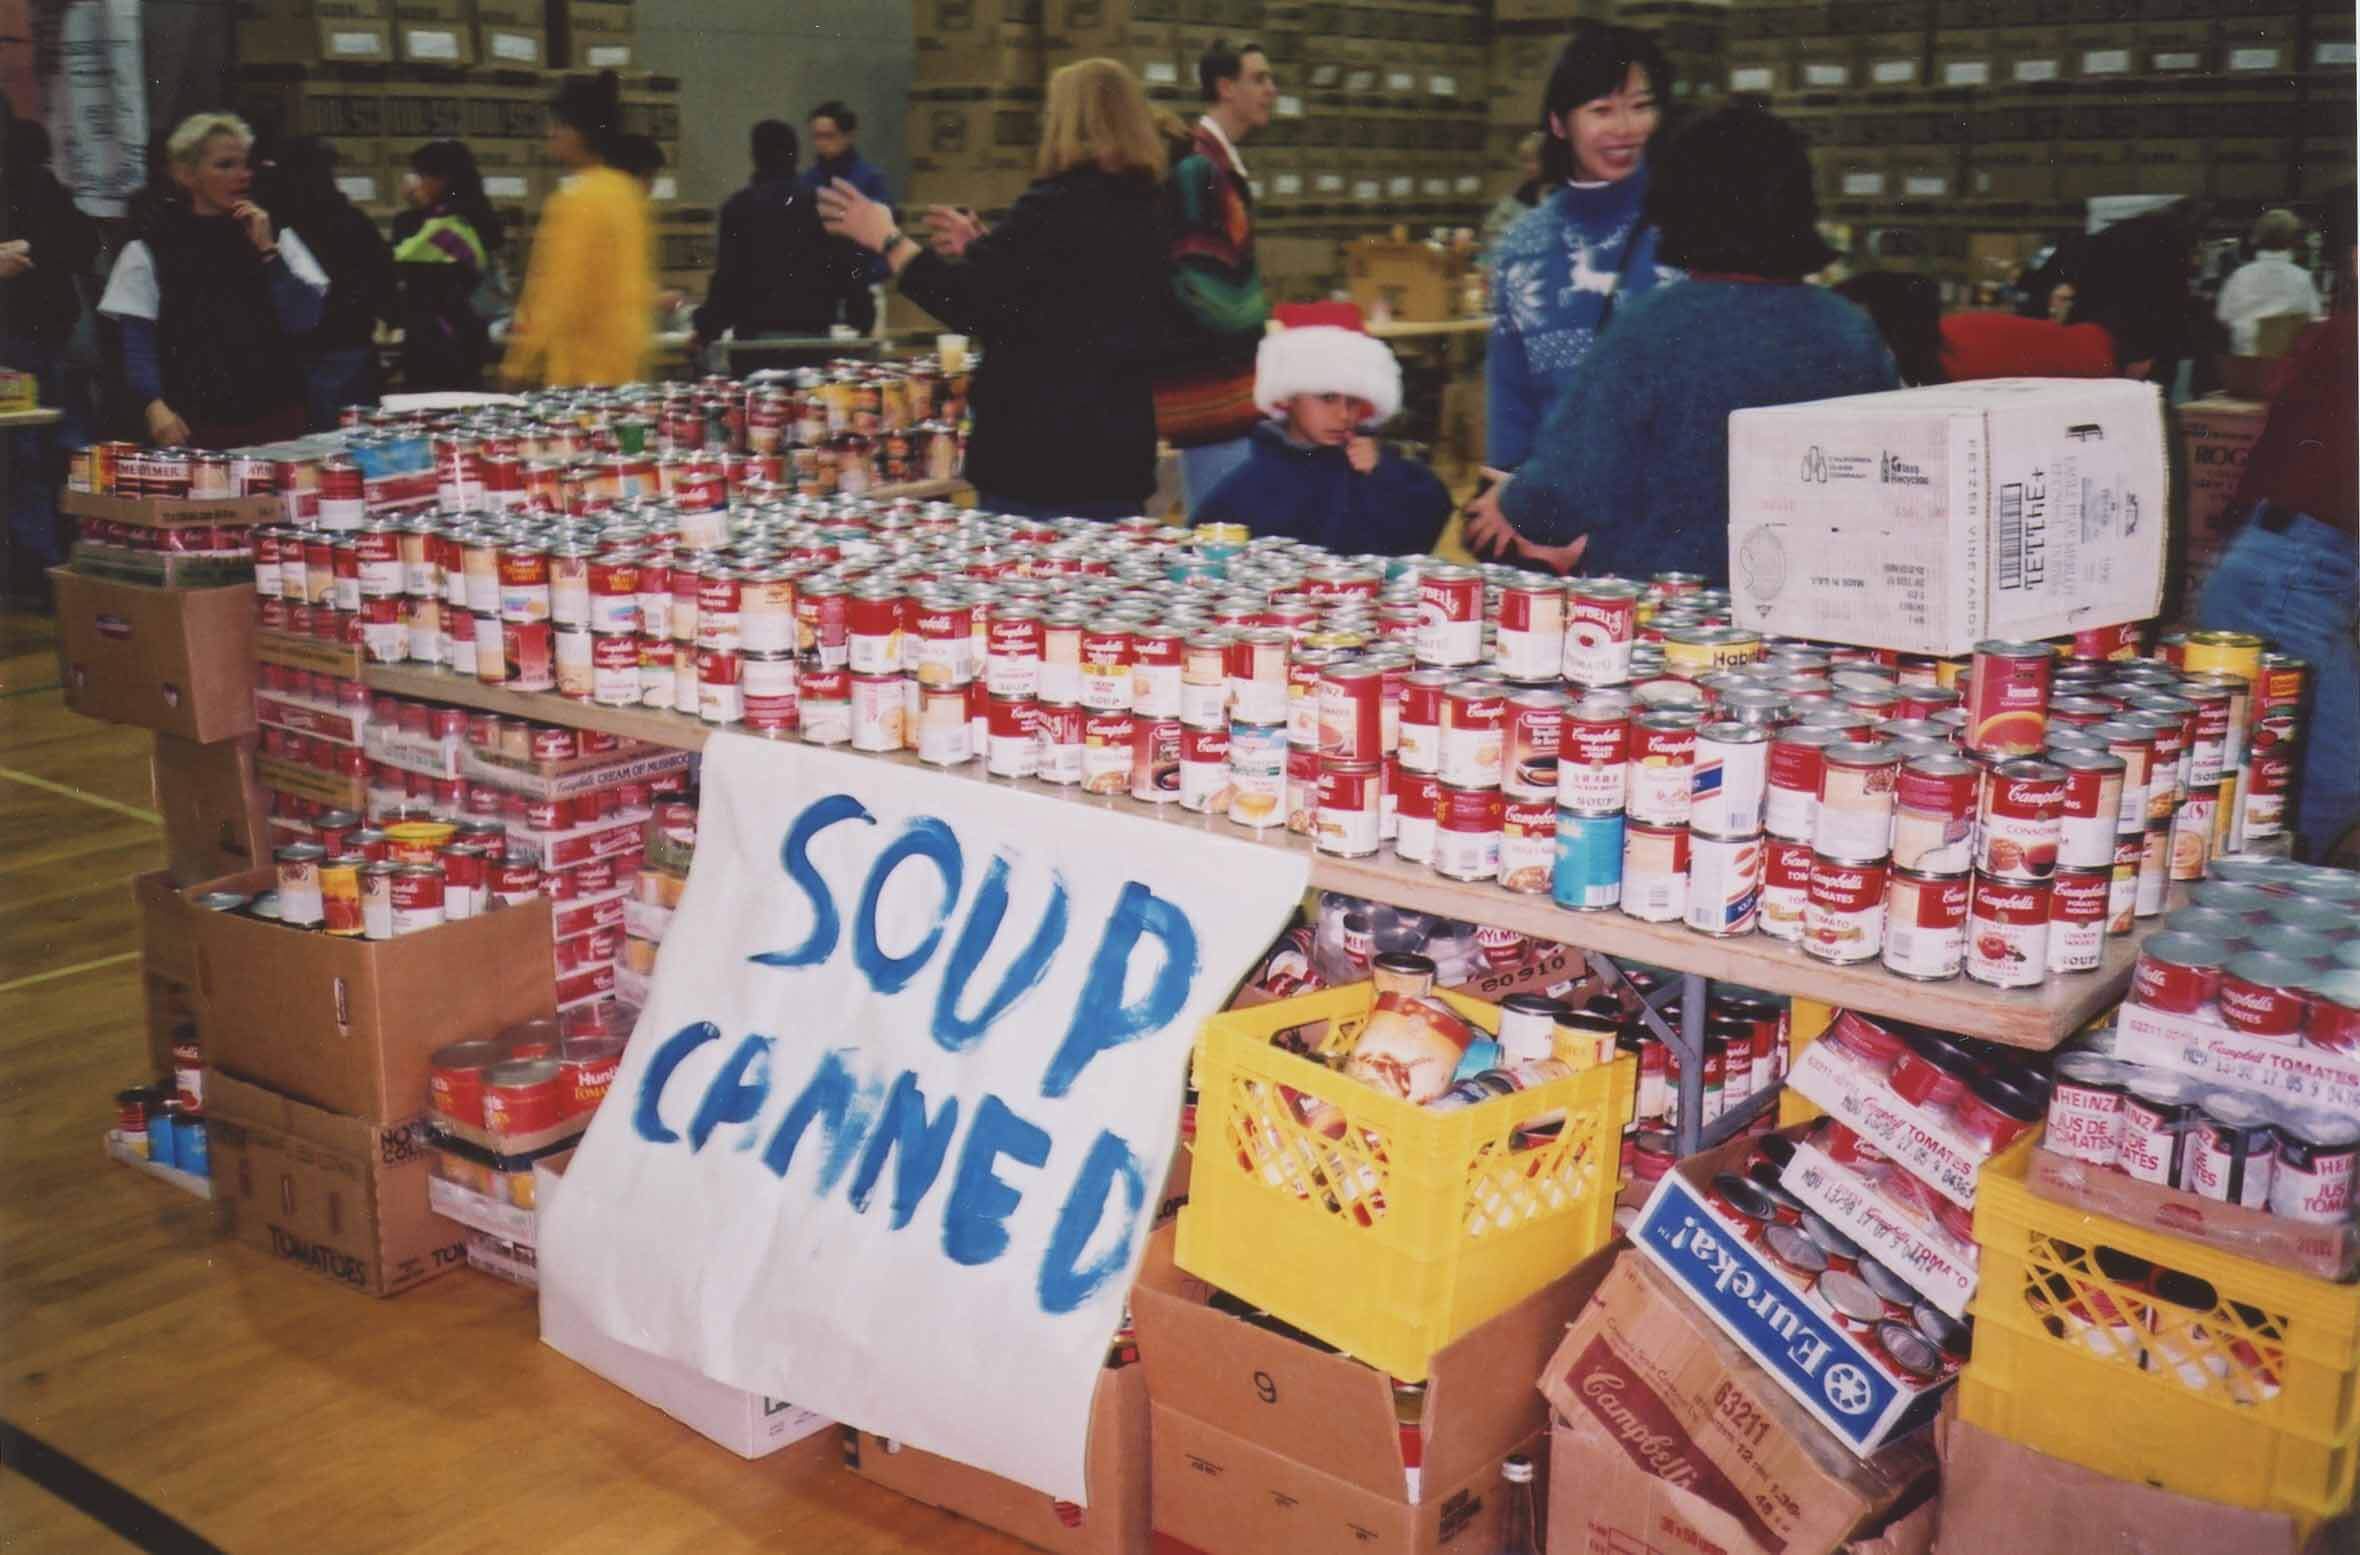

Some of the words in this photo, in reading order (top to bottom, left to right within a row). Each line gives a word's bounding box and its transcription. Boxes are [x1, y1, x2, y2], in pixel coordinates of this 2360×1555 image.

[747, 793, 1200, 1099] SOUP
[2058, 1087, 2114, 1113] HEINZ
[2086, 1119, 2109, 1135] DE
[631, 1021, 1146, 1316] CANNED
[1908, 1125, 1973, 1176] TOMATES
[1670, 1213, 1833, 1376] Eureka!
[1582, 1363, 1699, 1490] Campbell's
[1713, 1380, 1771, 1446] 63211
